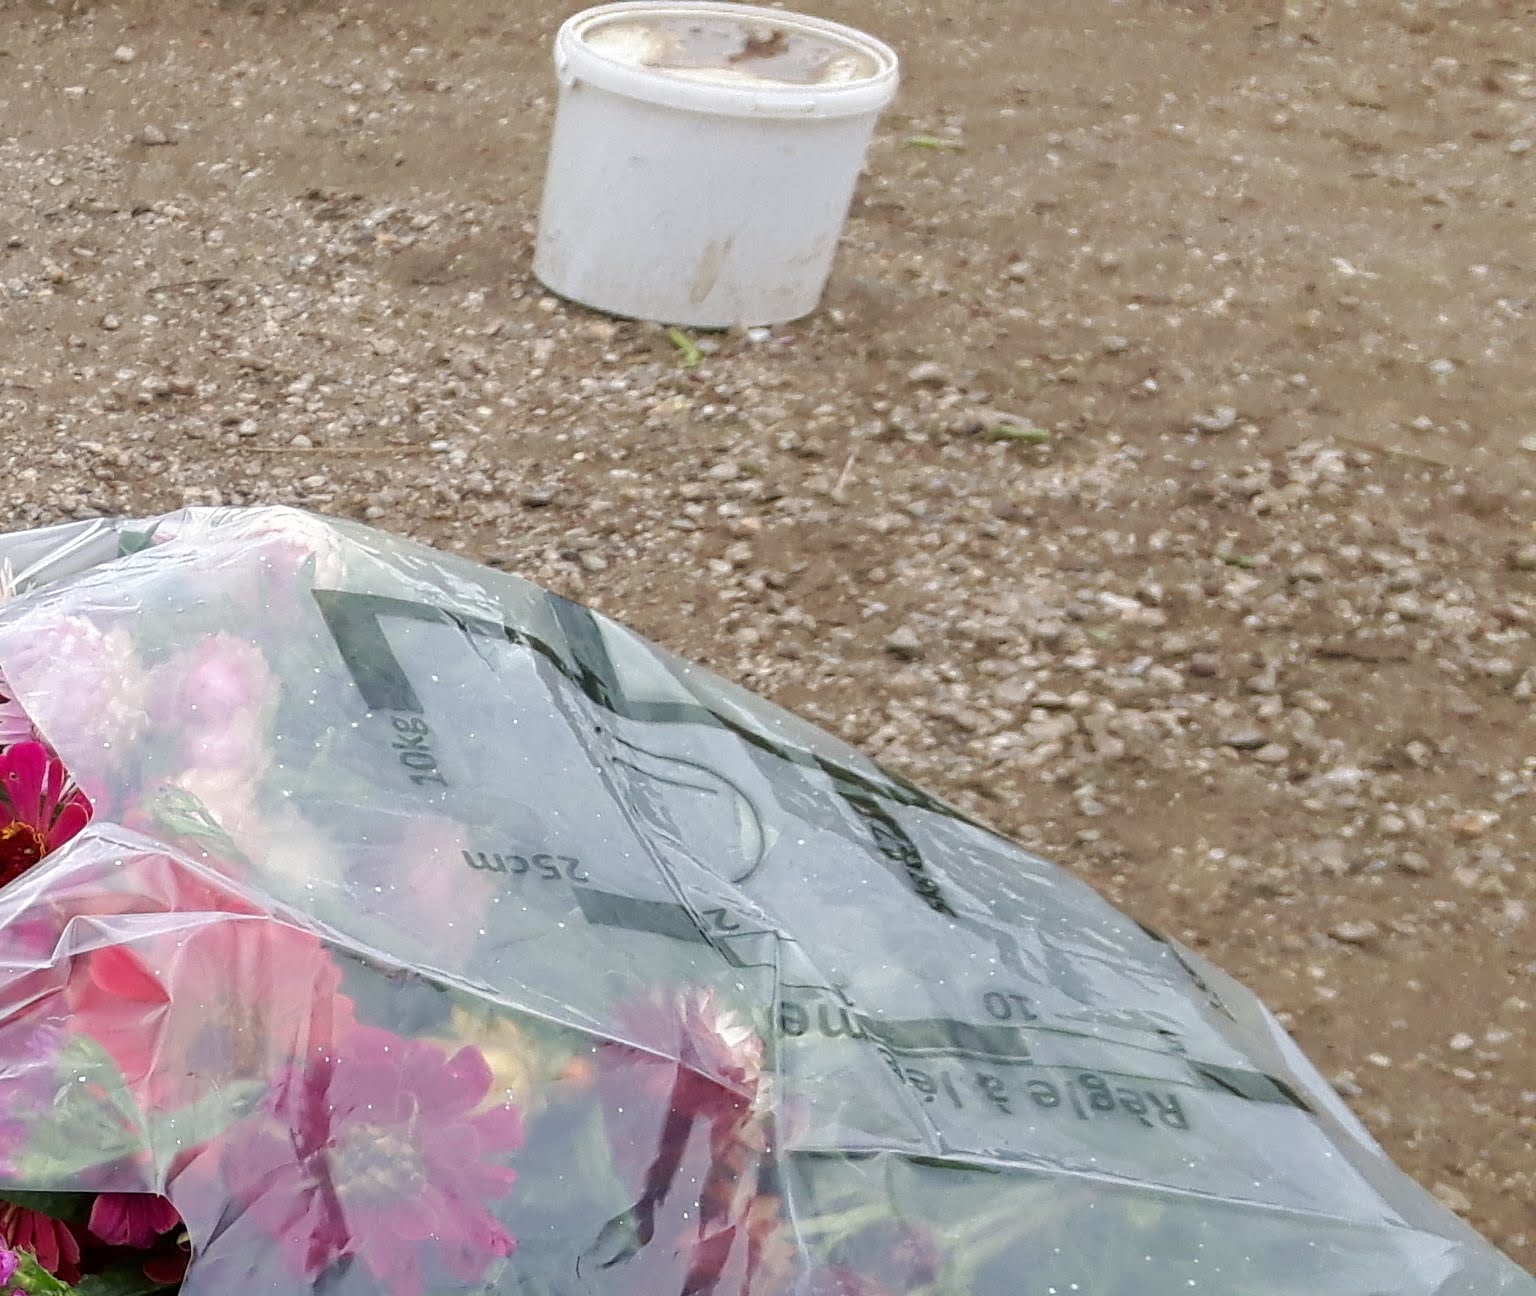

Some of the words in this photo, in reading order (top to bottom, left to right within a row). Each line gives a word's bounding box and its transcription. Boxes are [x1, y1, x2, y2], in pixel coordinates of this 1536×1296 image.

[391, 715, 449, 788] 10kg
[461, 849, 589, 883] 25cm
[1028, 1072, 1190, 1130] Règle
